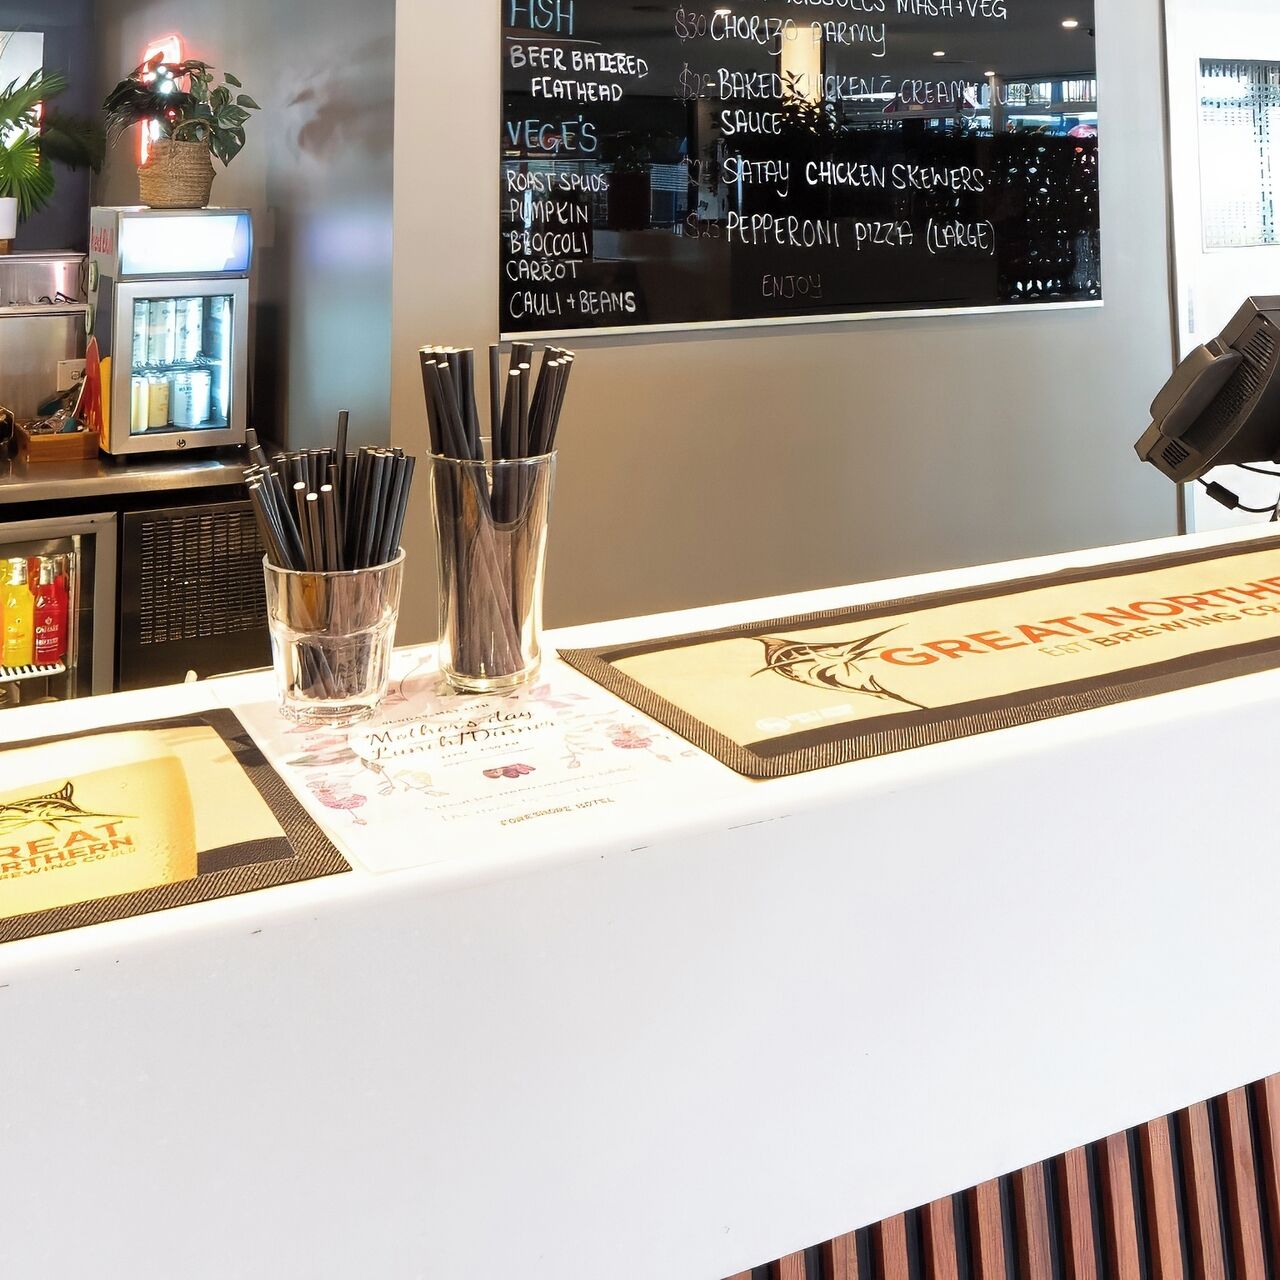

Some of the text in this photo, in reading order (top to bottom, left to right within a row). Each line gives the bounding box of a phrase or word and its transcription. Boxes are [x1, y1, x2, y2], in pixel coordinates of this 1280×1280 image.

[509, 45, 567, 71] BEER
[531, 77, 624, 103] FLATHEAD
[716, 67, 784, 101] BAKED
[720, 111, 783, 136] SAUCE
[506, 169, 557, 193] ROAST
[721, 156, 790, 198] SATAY
[805, 163, 886, 190] CHICKEN
[890, 165, 985, 194] SKEWERS
[509, 198, 589, 225] PUMPKIN
[510, 230, 589, 257] BROCCOLI
[725, 210, 840, 248] PEPPERONI
[855, 220, 914, 251] PIZZA
[926, 219, 995, 257] (LARGE)
[506, 258, 583, 283] CARROT
[761, 273, 823, 299] ENJOY
[509, 291, 561, 319] CAULI
[578, 290, 637, 315] BEANS
[879, 616, 1093, 667] GREAT
[1087, 611, 1243, 648] BREWING
